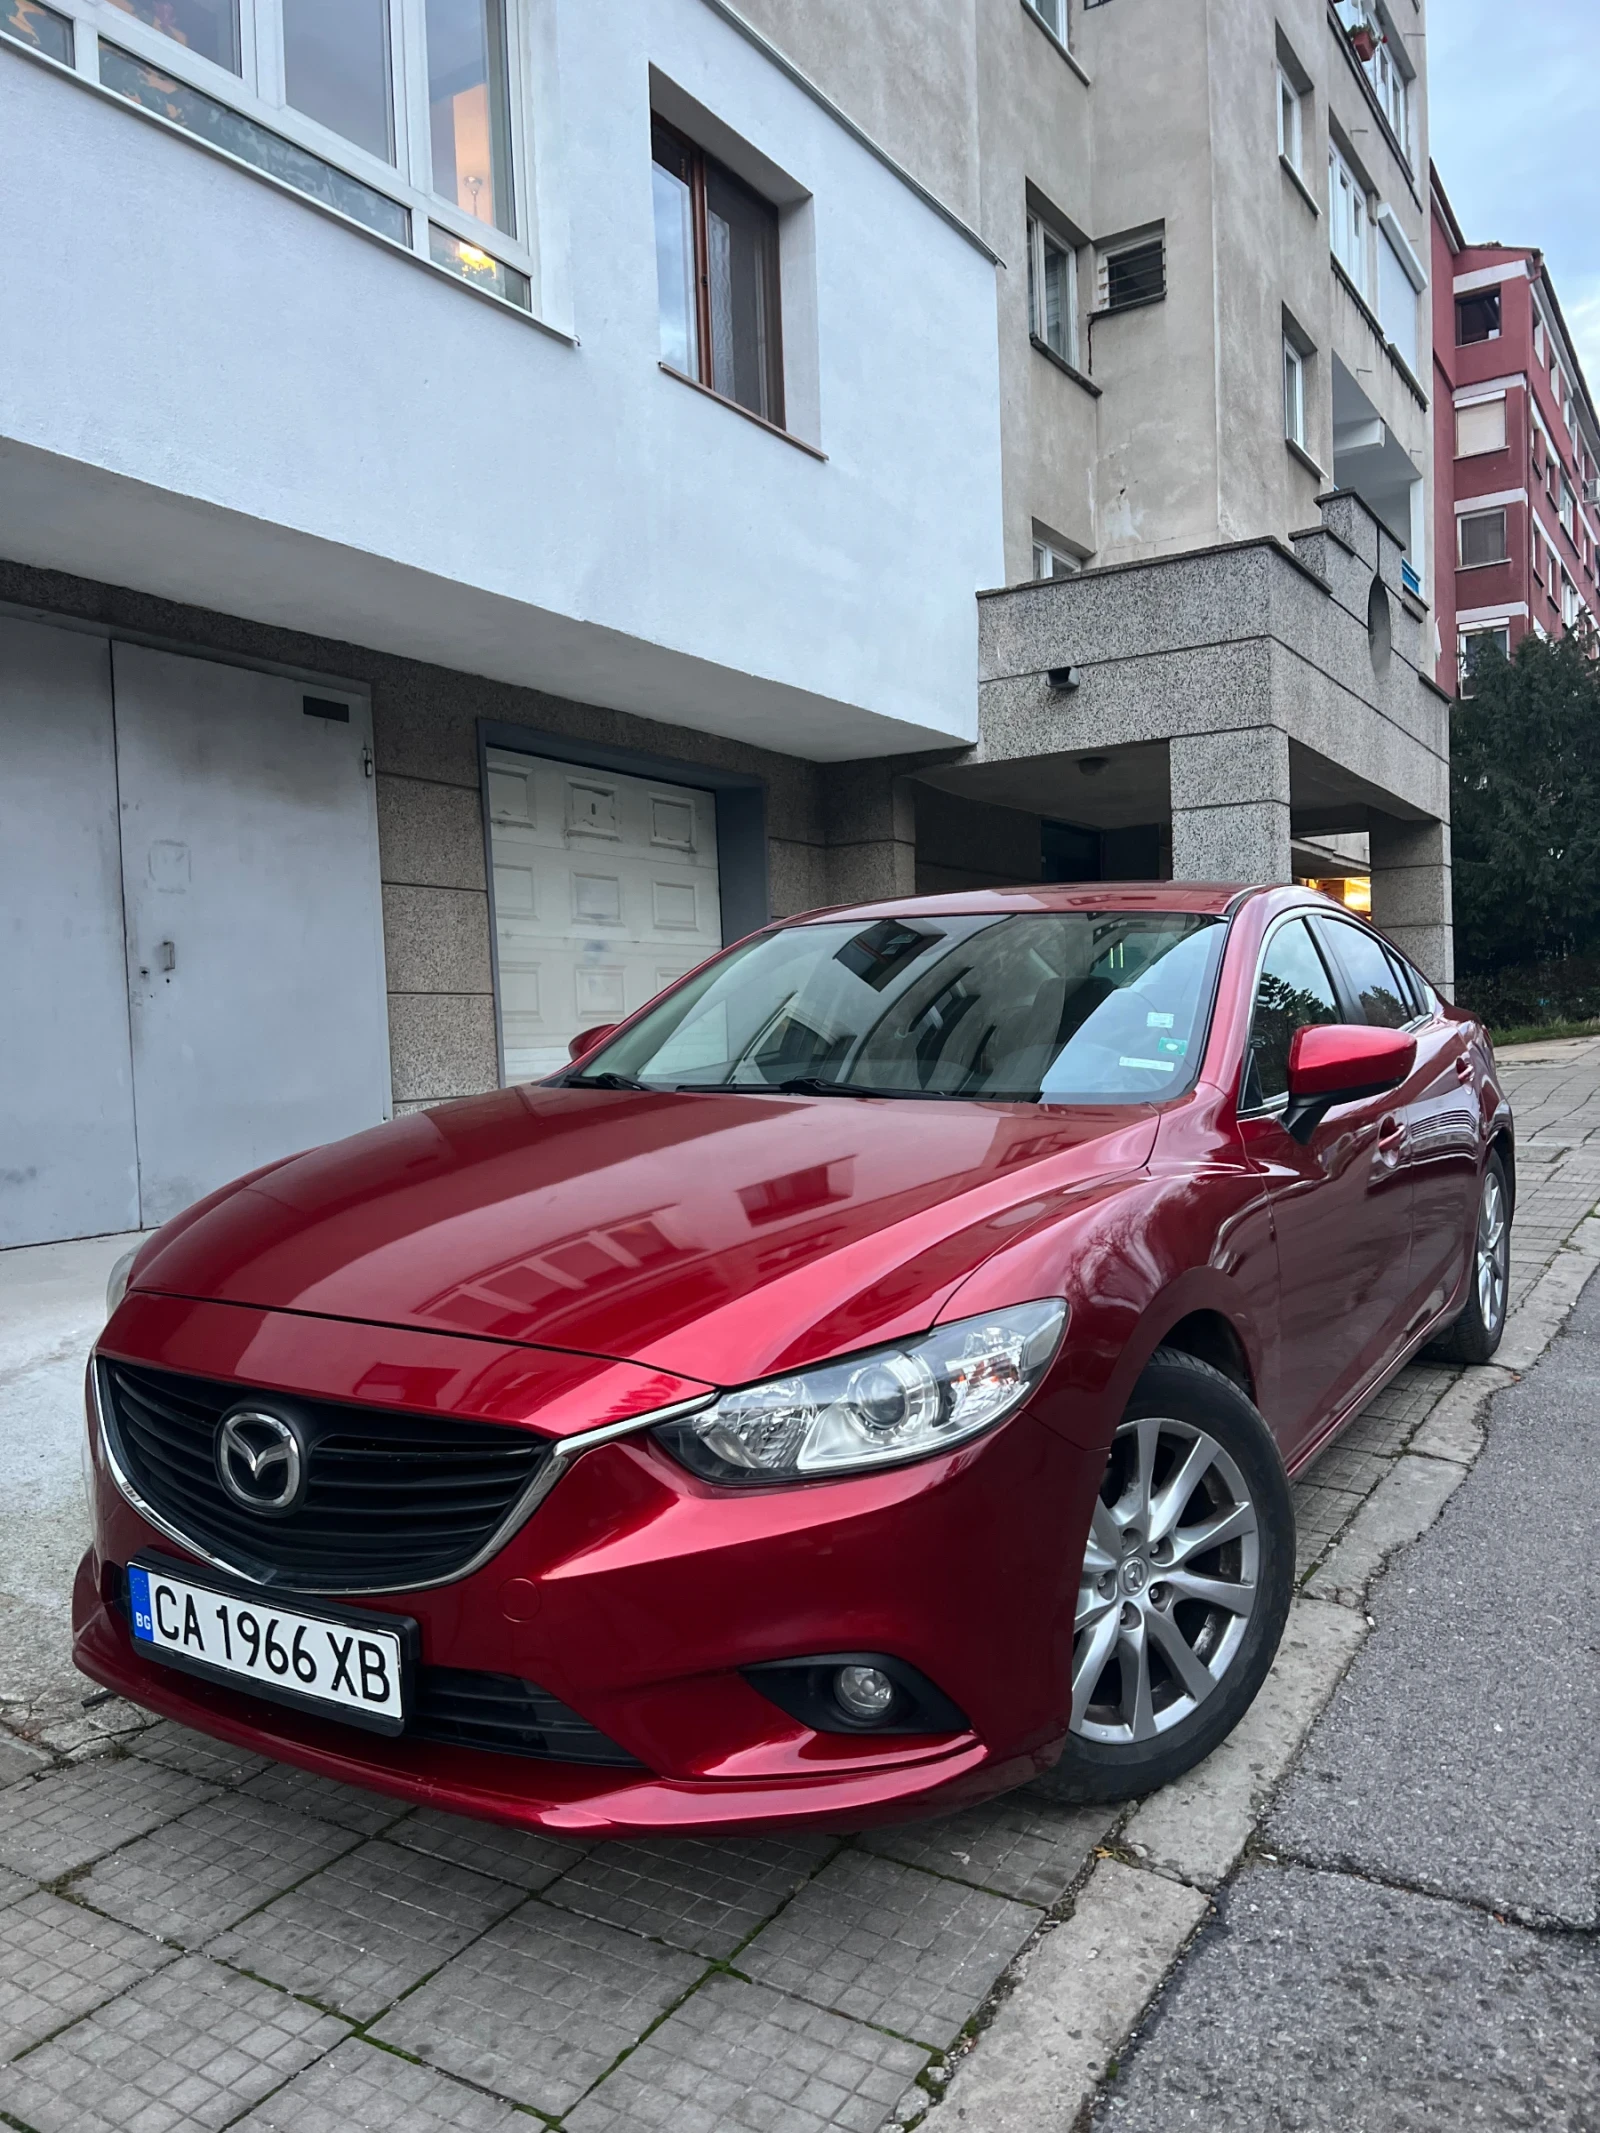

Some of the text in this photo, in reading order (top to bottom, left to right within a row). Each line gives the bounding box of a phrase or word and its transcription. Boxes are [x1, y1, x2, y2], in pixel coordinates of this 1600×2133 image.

[136, 1612, 151, 1630] BG
[155, 1585, 390, 1703] CA 1966 XB
